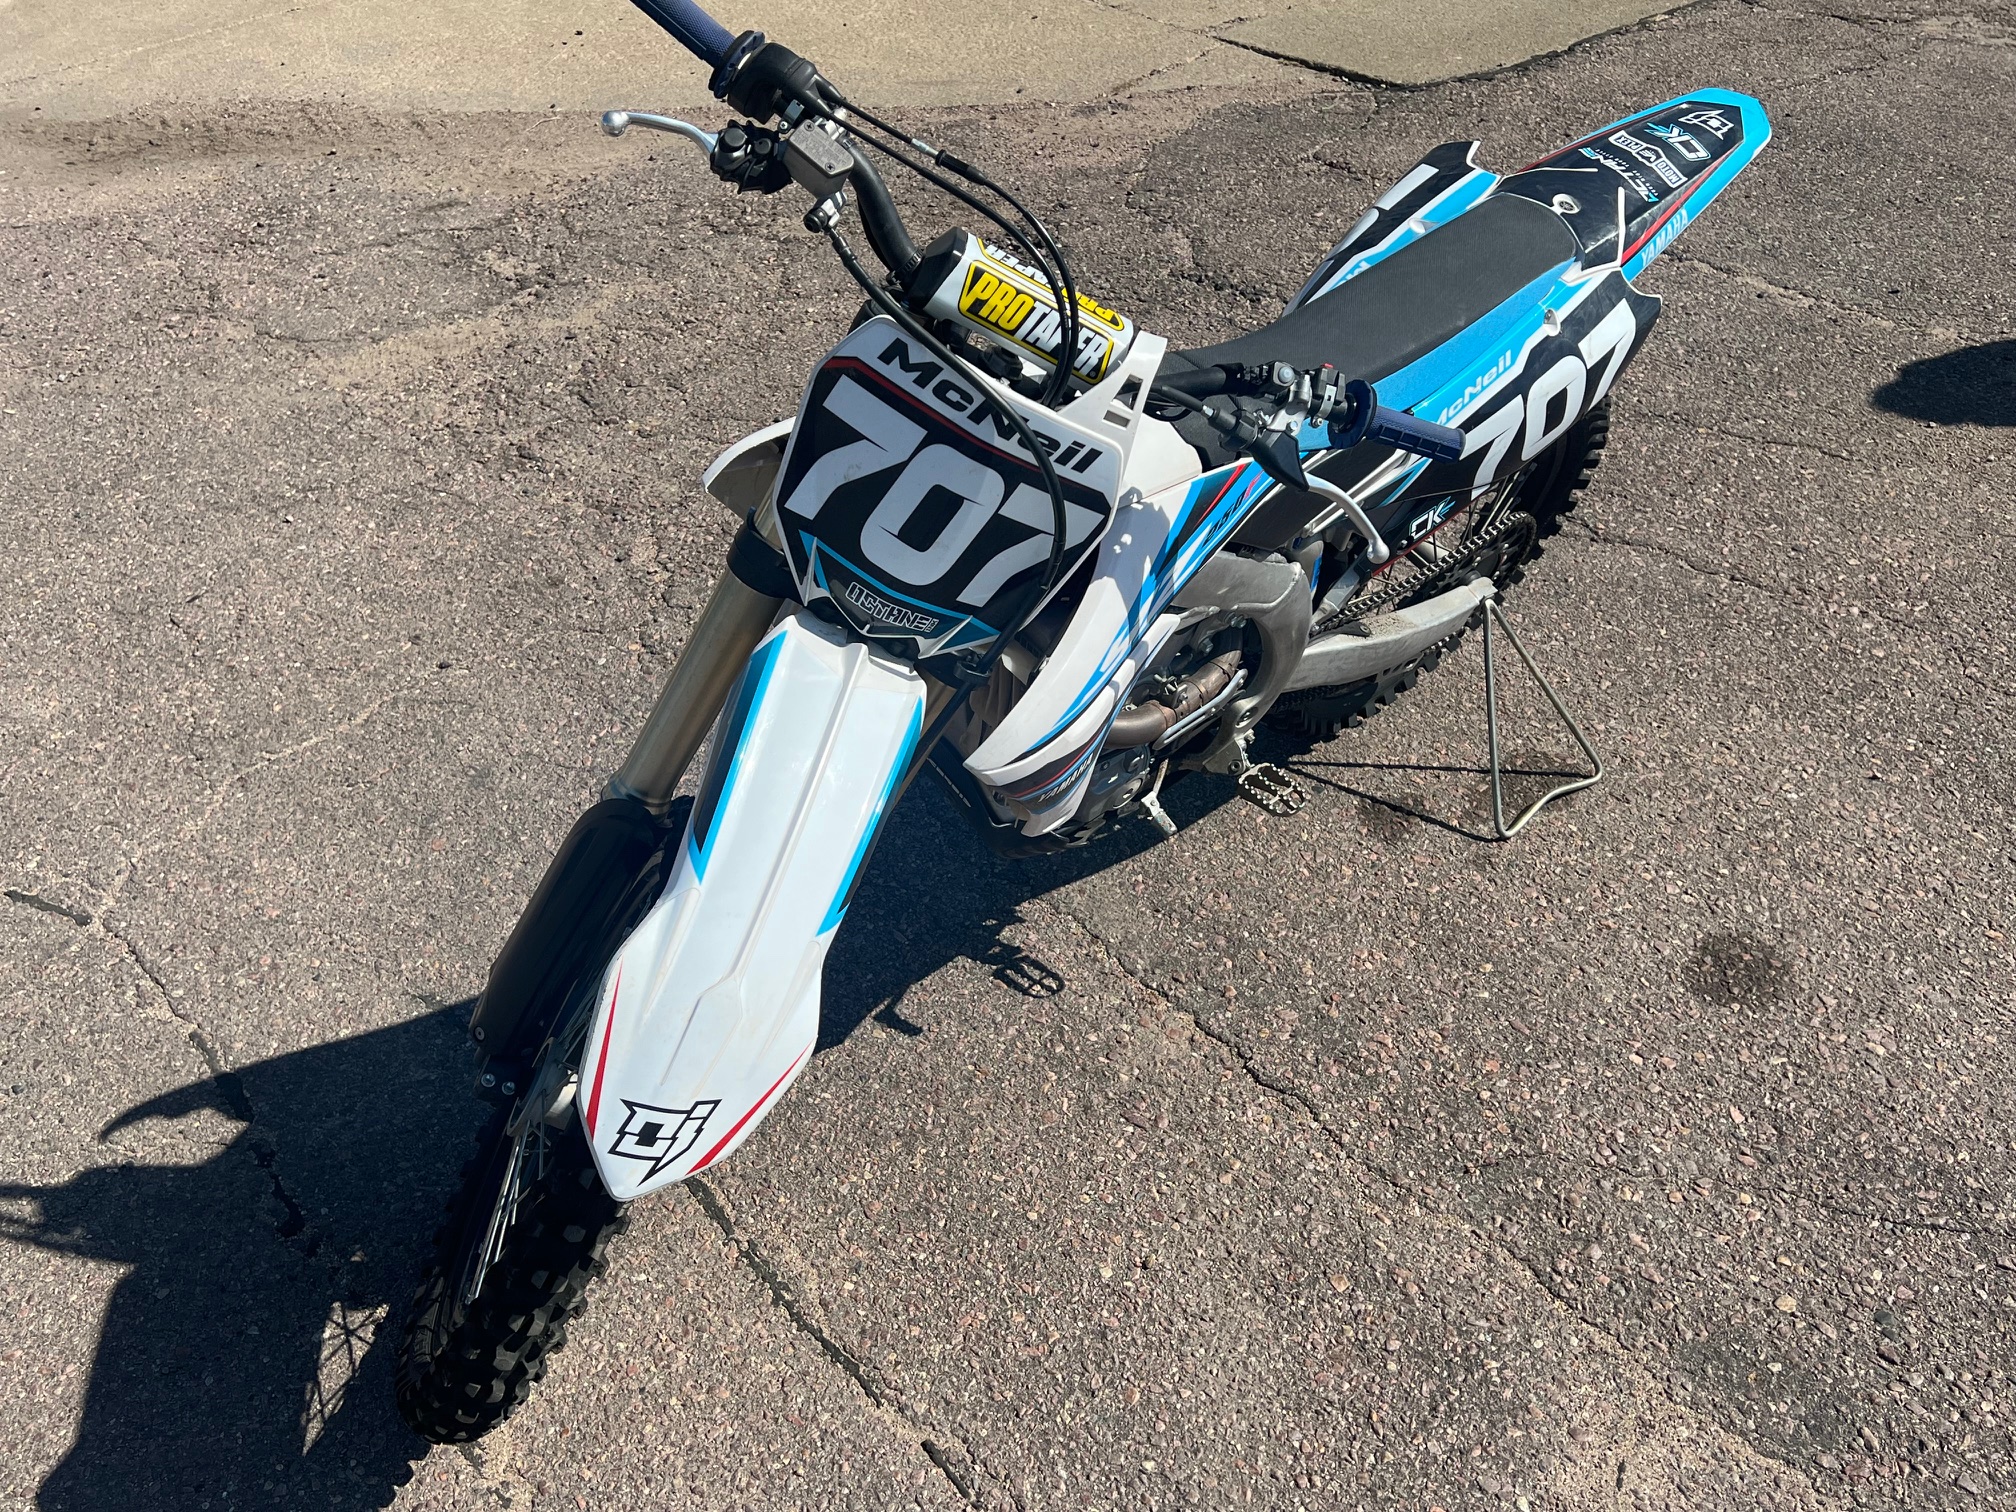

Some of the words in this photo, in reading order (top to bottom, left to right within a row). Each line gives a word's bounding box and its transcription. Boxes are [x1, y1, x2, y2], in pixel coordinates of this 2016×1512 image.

[1615, 134, 1643, 150] PLEX
[1644, 121, 1712, 161] CK
[1578, 147, 1660, 202] OCTANE
[1656, 160, 1682, 184] MOTO
[1640, 207, 1690, 267] YAMAHA
[878, 337, 1104, 474] McNeil
[1433, 349, 1513, 426] McNeil
[1459, 297, 1637, 502] 707
[784, 374, 1106, 608] 707
[1409, 496, 1456, 540] CK
[845, 581, 932, 632] OCTANE
[1038, 753, 1094, 803] YAMAHA
